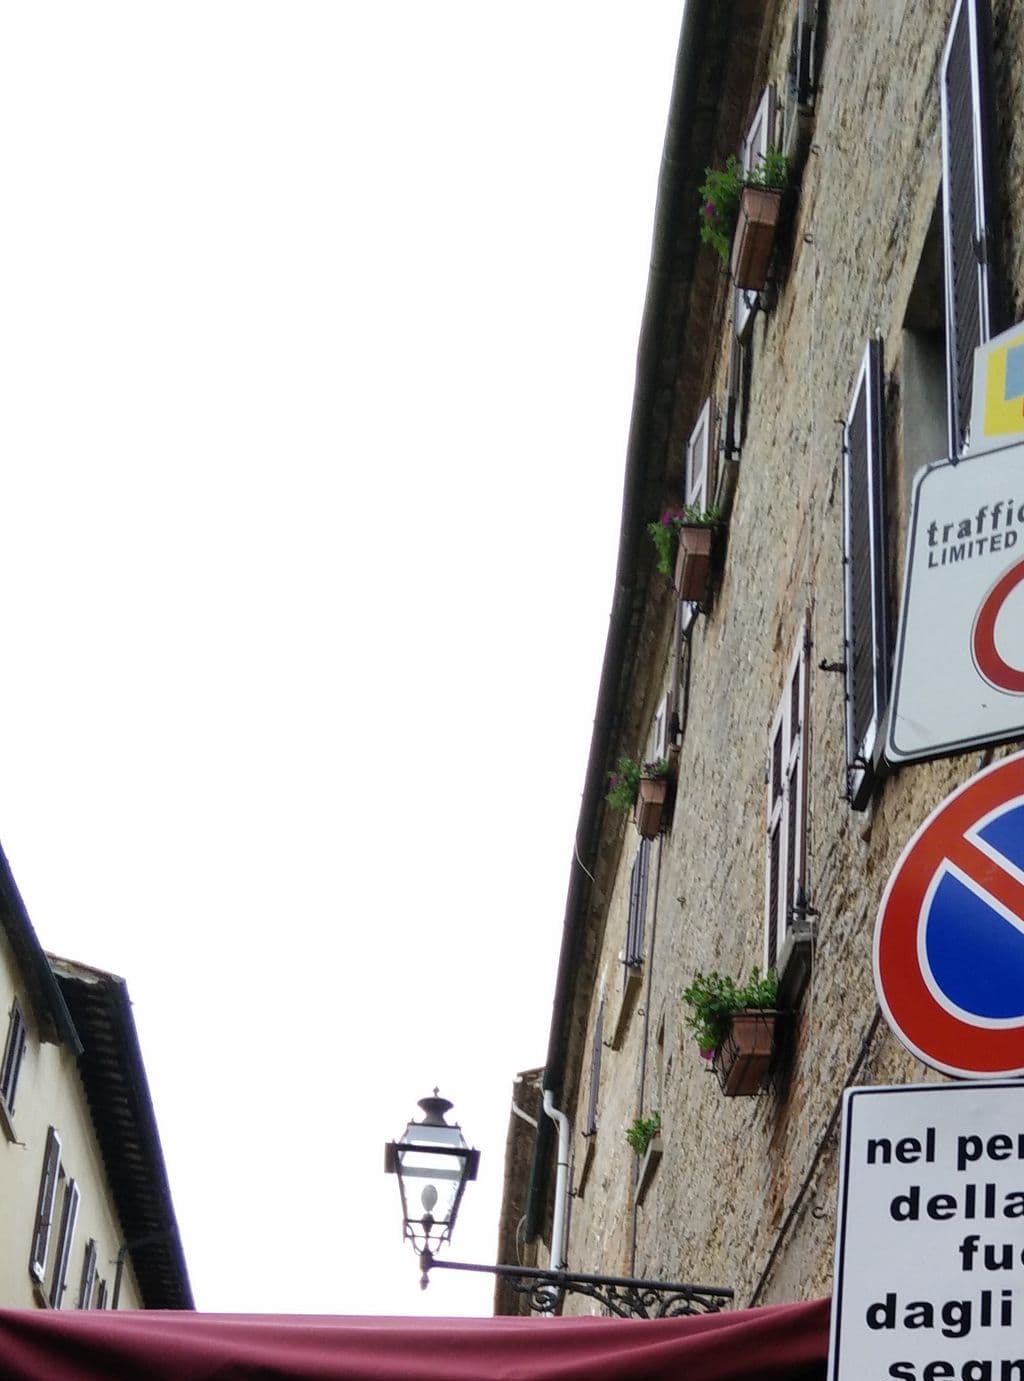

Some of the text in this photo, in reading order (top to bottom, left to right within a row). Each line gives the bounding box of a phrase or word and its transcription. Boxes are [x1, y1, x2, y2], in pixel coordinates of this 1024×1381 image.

[927, 530, 1018, 569] LIMITED
[866, 1127, 936, 1165] nel
[865, 1289, 1013, 1339] dagli
